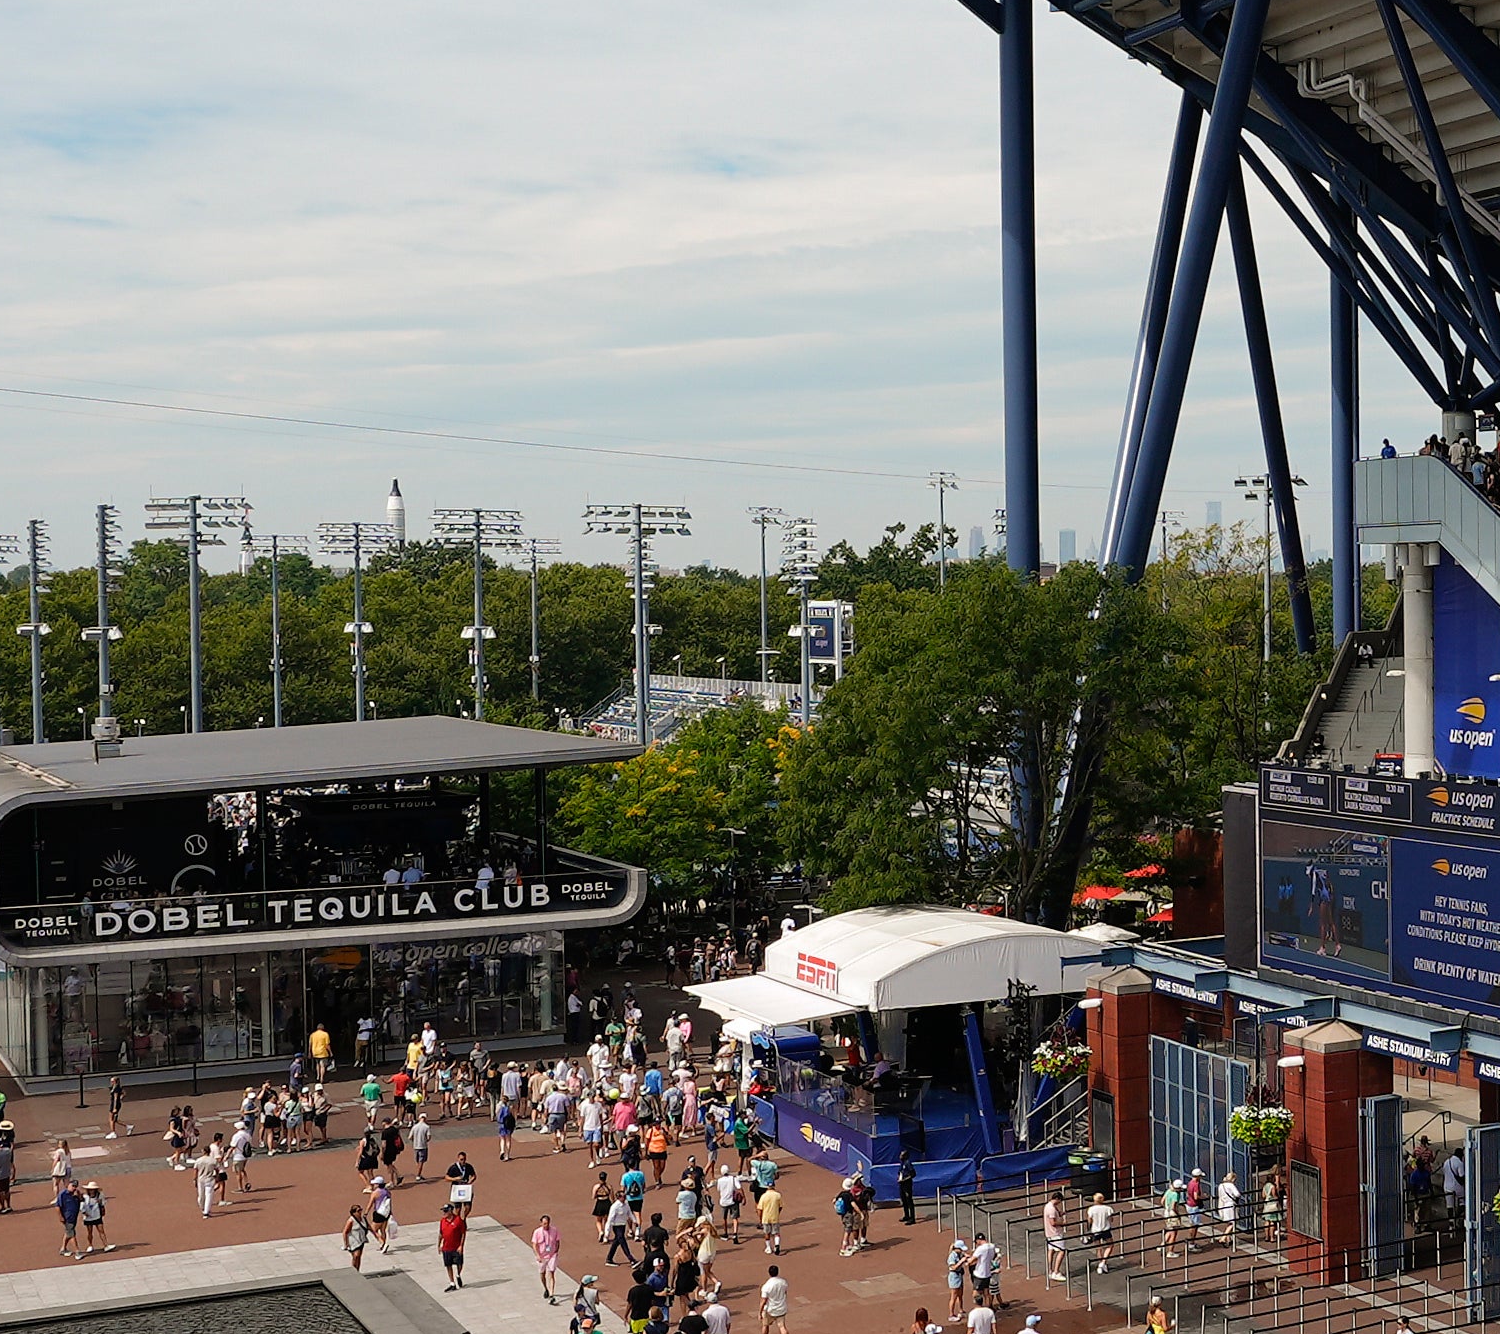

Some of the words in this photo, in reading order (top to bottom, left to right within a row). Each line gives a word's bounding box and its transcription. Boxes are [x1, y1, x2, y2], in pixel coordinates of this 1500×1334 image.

[1449, 729, 1463, 744] us
[1464, 730, 1494, 750] open
[352, 802, 392, 812] DOBEL
[394, 800, 437, 810] TEQUILA
[1452, 792, 1465, 806] us
[1465, 793, 1494, 812] open
[1431, 811, 1462, 826] PRACTICE
[1462, 815, 1495, 829] SCHEDULE
[1452, 863, 1463, 875] us
[1463, 865, 1487, 880] open
[92, 875, 148, 888] DOBEL
[561, 881, 614, 895] DOBEL
[570, 892, 607, 902] TEQUILA
[1434, 895, 1448, 907] HEY
[1448, 897, 1470, 912] TENNIS
[95, 903, 249, 936] DOBEL
[268, 893, 437, 924] TEQUILA
[453, 884, 550, 913] CLUB
[14, 915, 78, 929] DOBEL
[1420, 909, 1436, 923] WITH
[1436, 913, 1462, 928] TODAY'S
[1462, 917, 1476, 930] HOT
[26, 928, 70, 938] TEQUILA
[1407, 924, 1443, 941] CONDITIONS
[1443, 930, 1467, 945] PLEASE
[1467, 935, 1484, 948] KEEP
[405, 943, 460, 965] open
[796, 952, 837, 991] ESPN
[1413, 957, 1437, 973] DRINK
[1437, 962, 1465, 979] PLENTY
[1465, 968, 1478, 981] OF
[1155, 978, 1172, 992] ASHE
[1238, 1000, 1257, 1015] ASHE
[1366, 1034, 1389, 1052] ASHE
[1389, 1039, 1422, 1061] STADIUM
[821, 1133, 842, 1153] open
